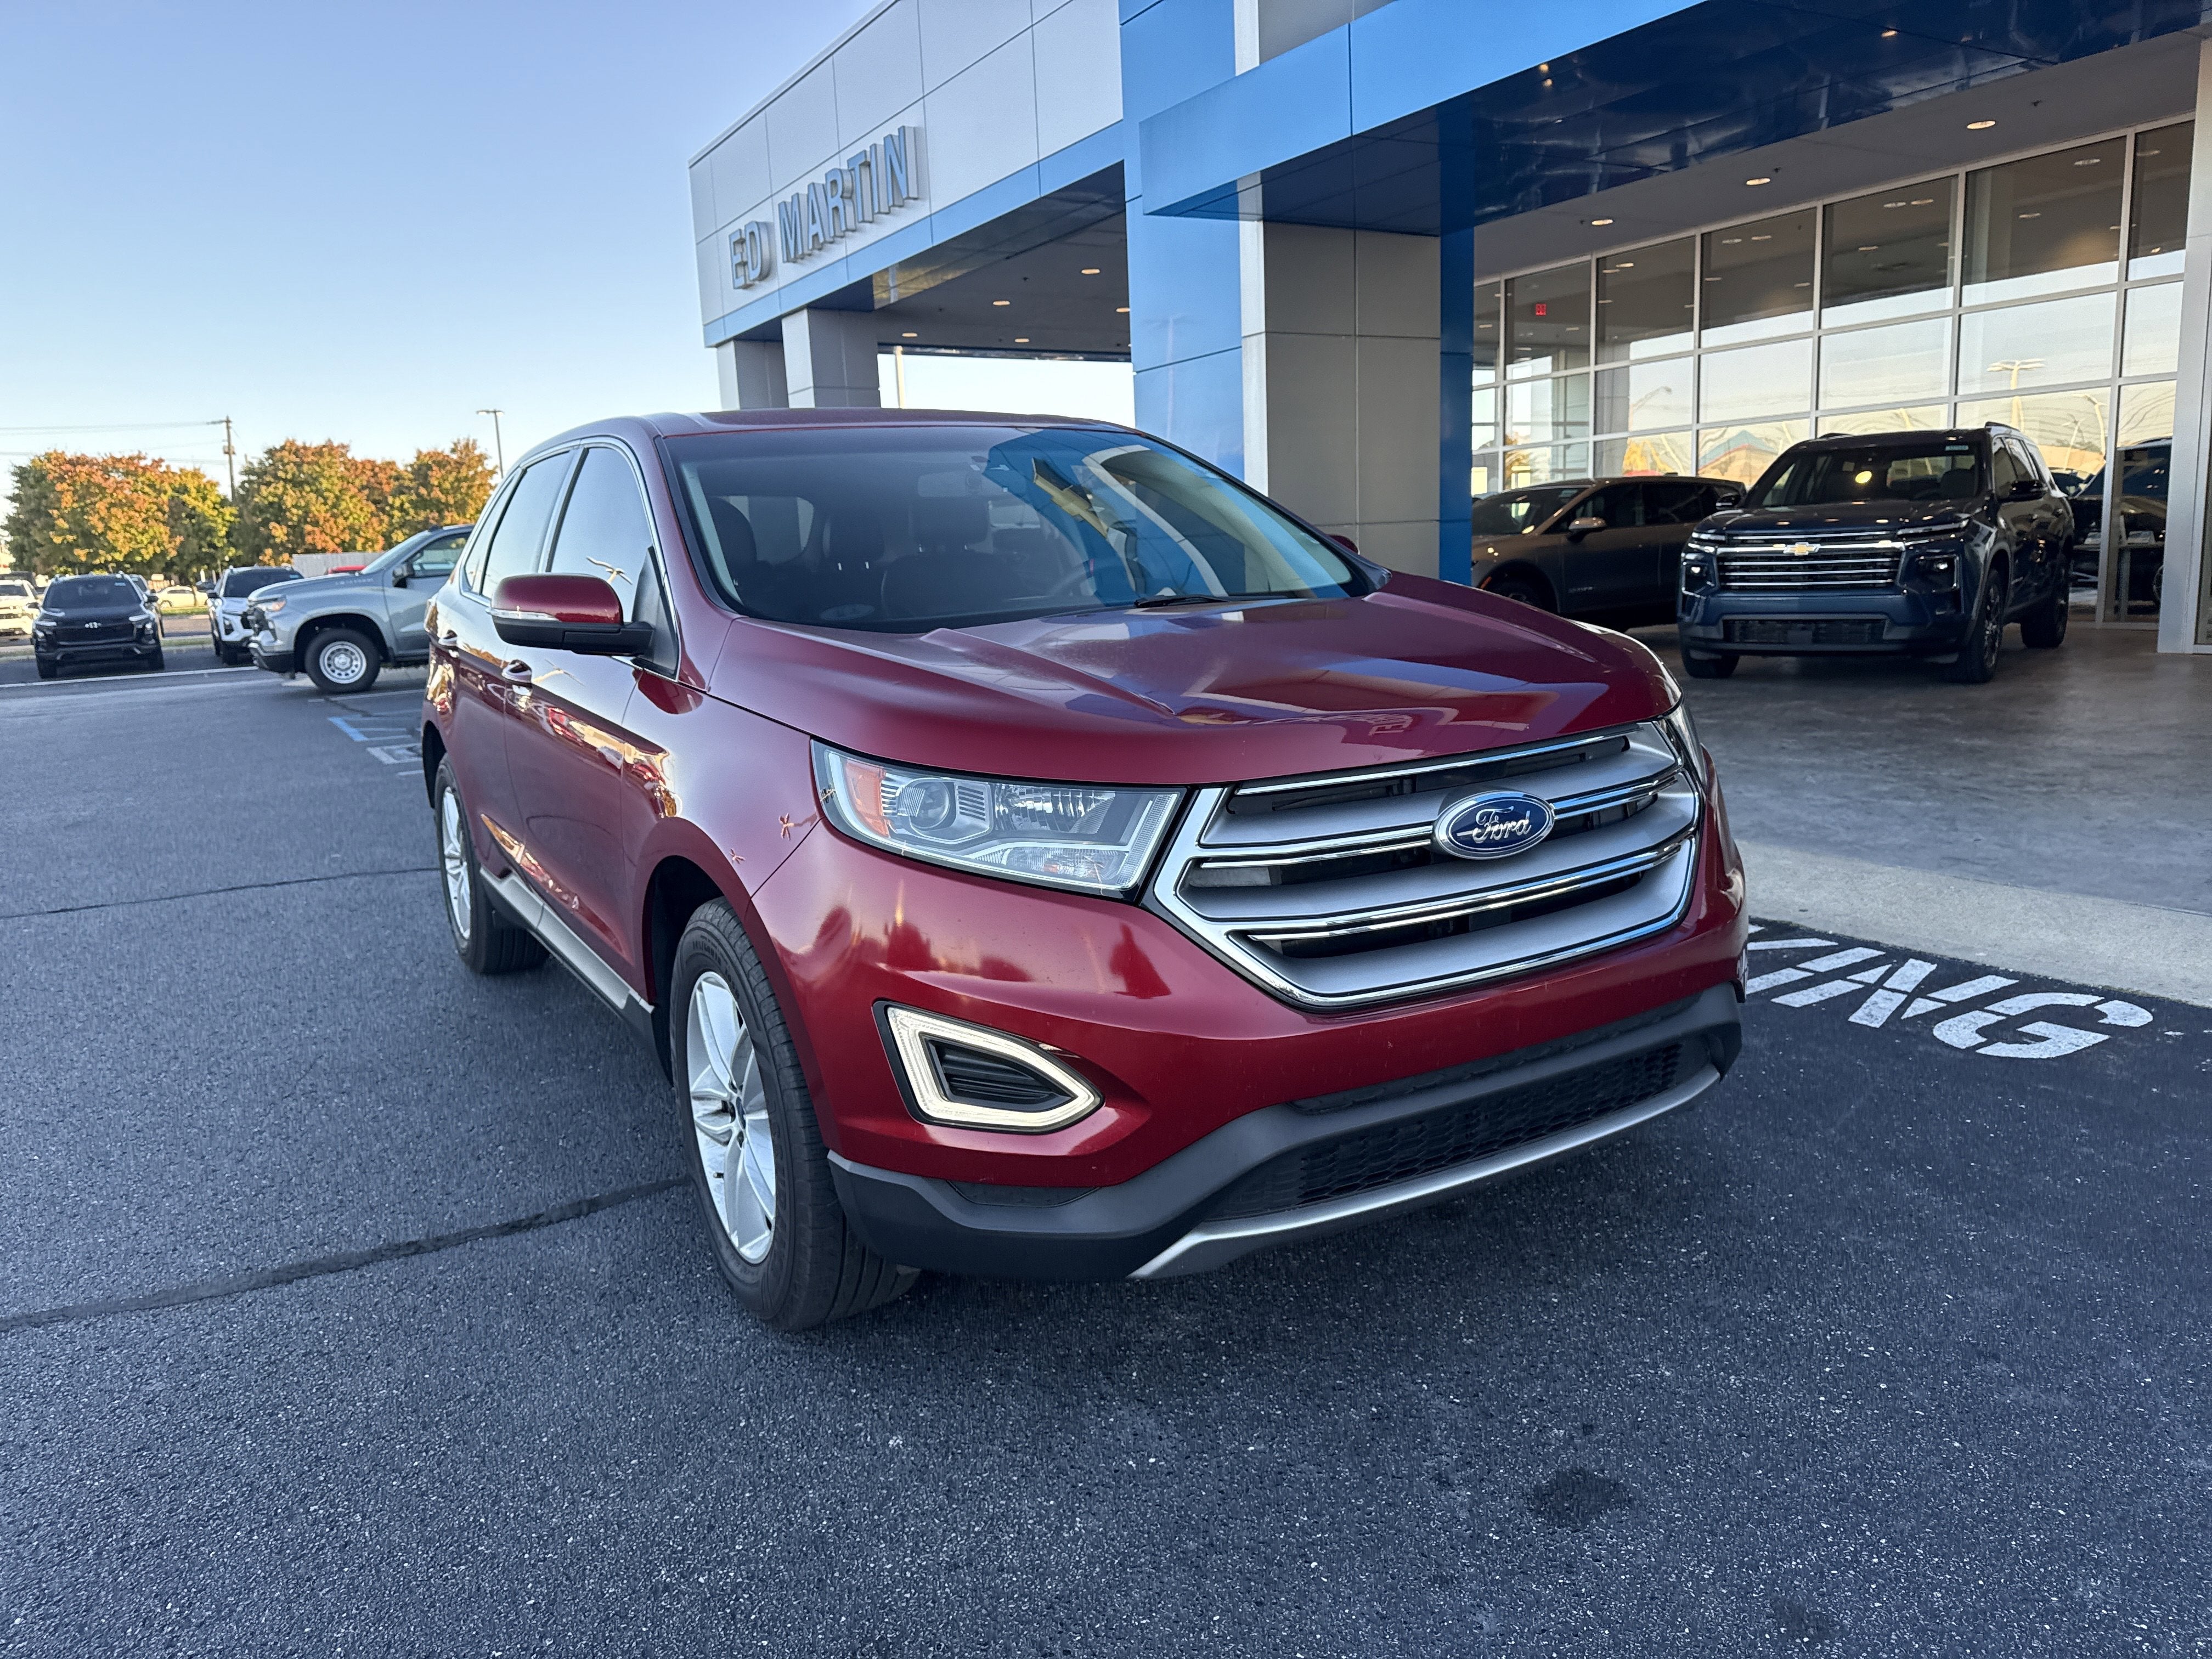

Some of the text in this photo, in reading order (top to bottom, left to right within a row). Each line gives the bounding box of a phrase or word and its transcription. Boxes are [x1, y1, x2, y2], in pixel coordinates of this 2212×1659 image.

[729, 125, 917, 289] ED MARTIN
[1457, 805, 1532, 844] Ford
